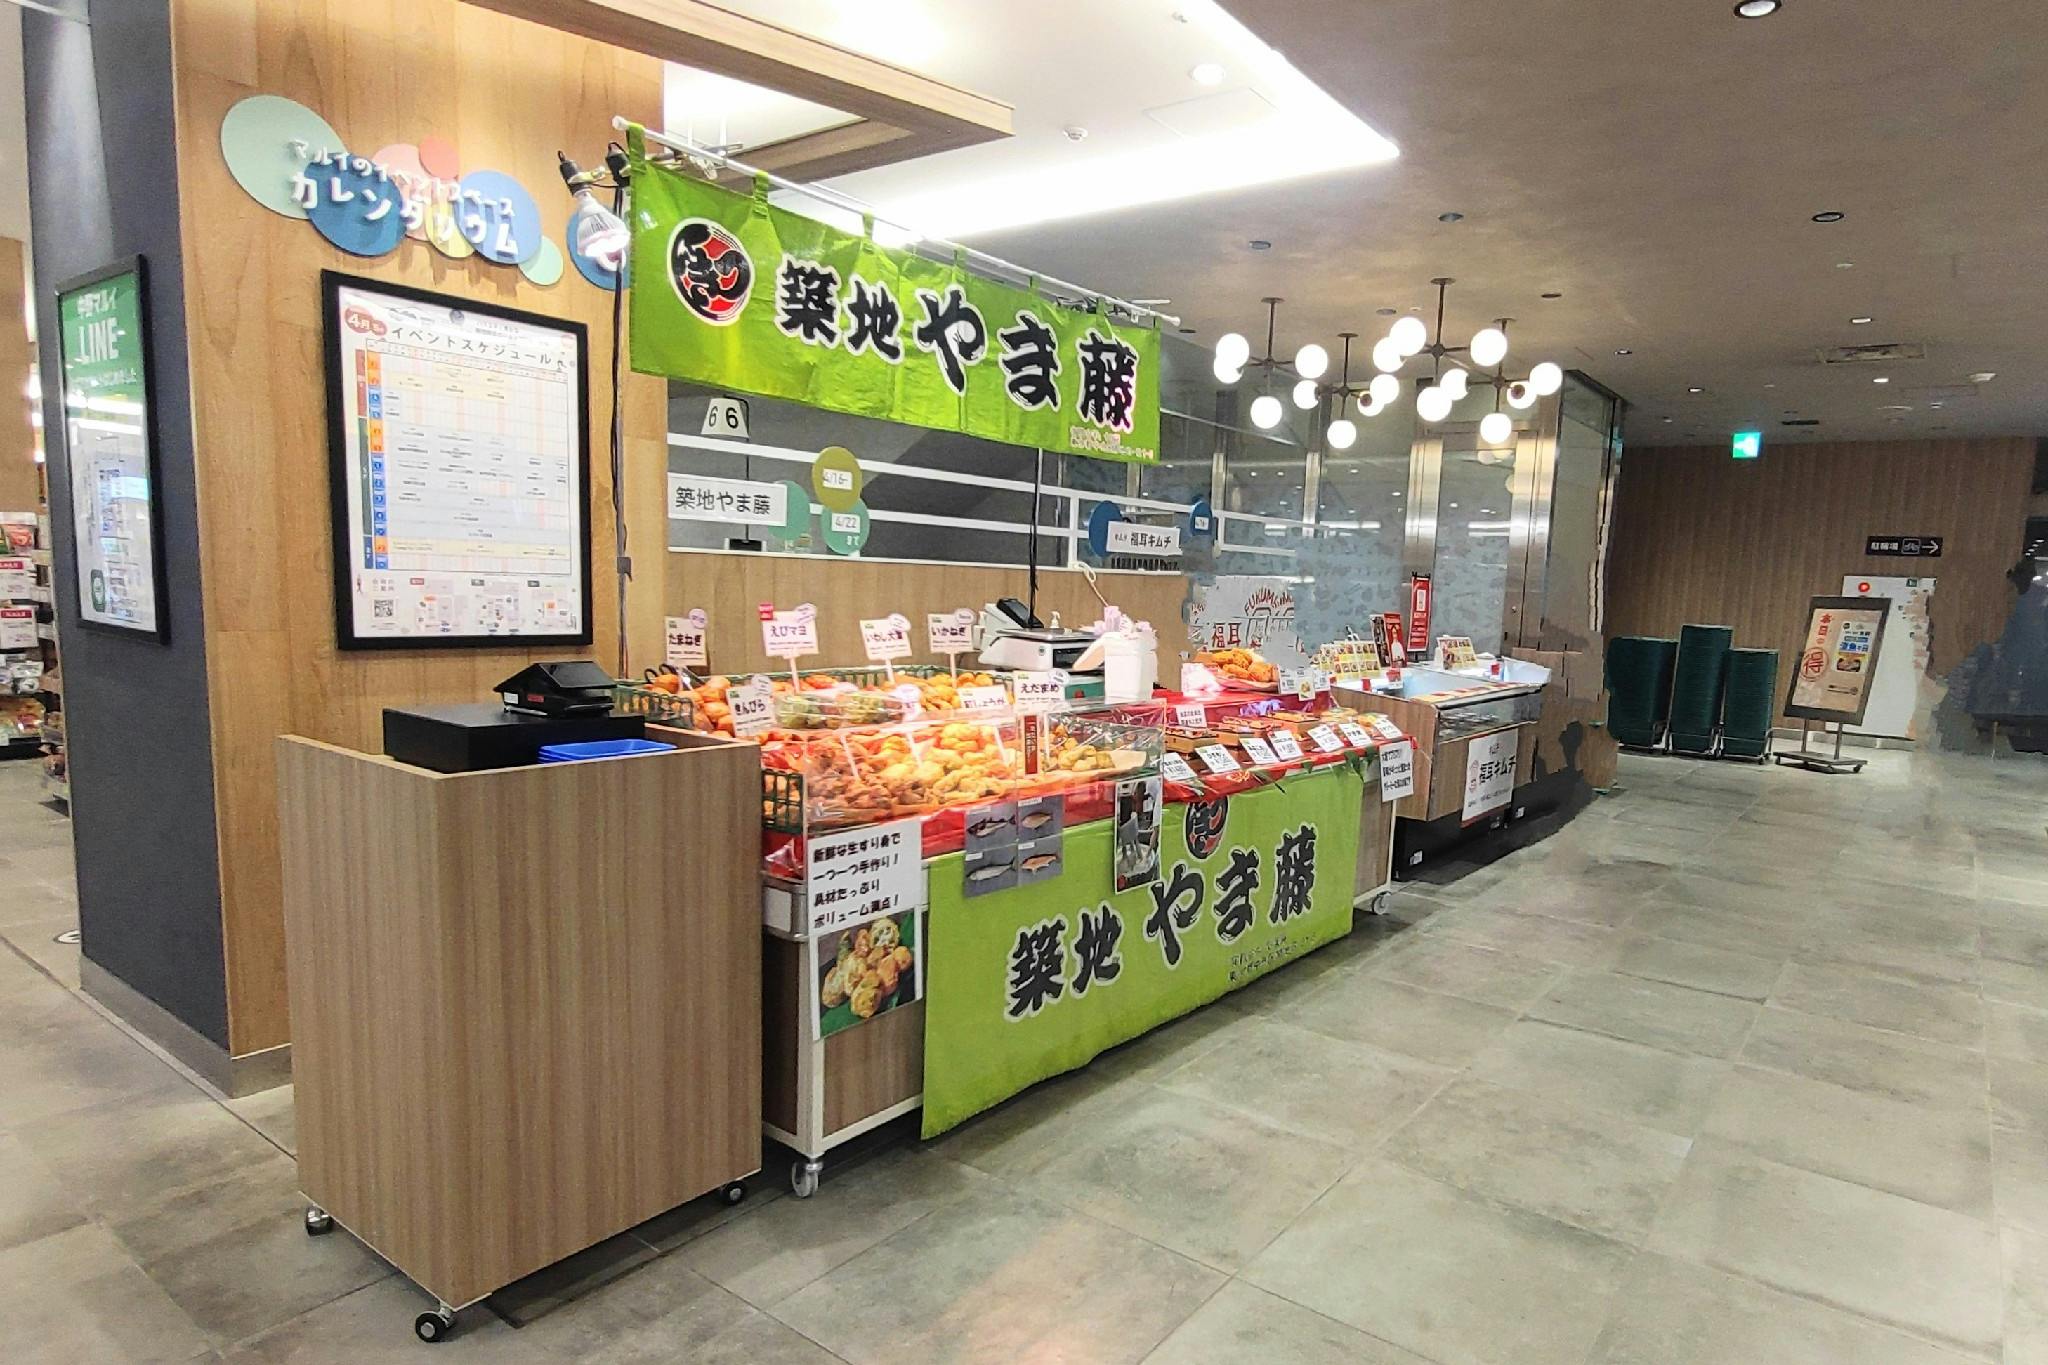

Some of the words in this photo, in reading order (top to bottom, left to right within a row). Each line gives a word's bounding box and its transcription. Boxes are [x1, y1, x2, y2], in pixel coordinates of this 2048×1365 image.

[79, 317, 119, 364] LINE
[391, 326, 553, 366] イベントスケジュール
[775, 253, 1140, 433] 築地やま藤
[675, 486, 771, 515] 築地やま藤
[668, 633, 703, 647] たまねぎ
[770, 625, 808, 637] えびマヨ
[1020, 682, 1060, 695] えだまめ
[1004, 820, 1319, 1023] 築地やま藤
